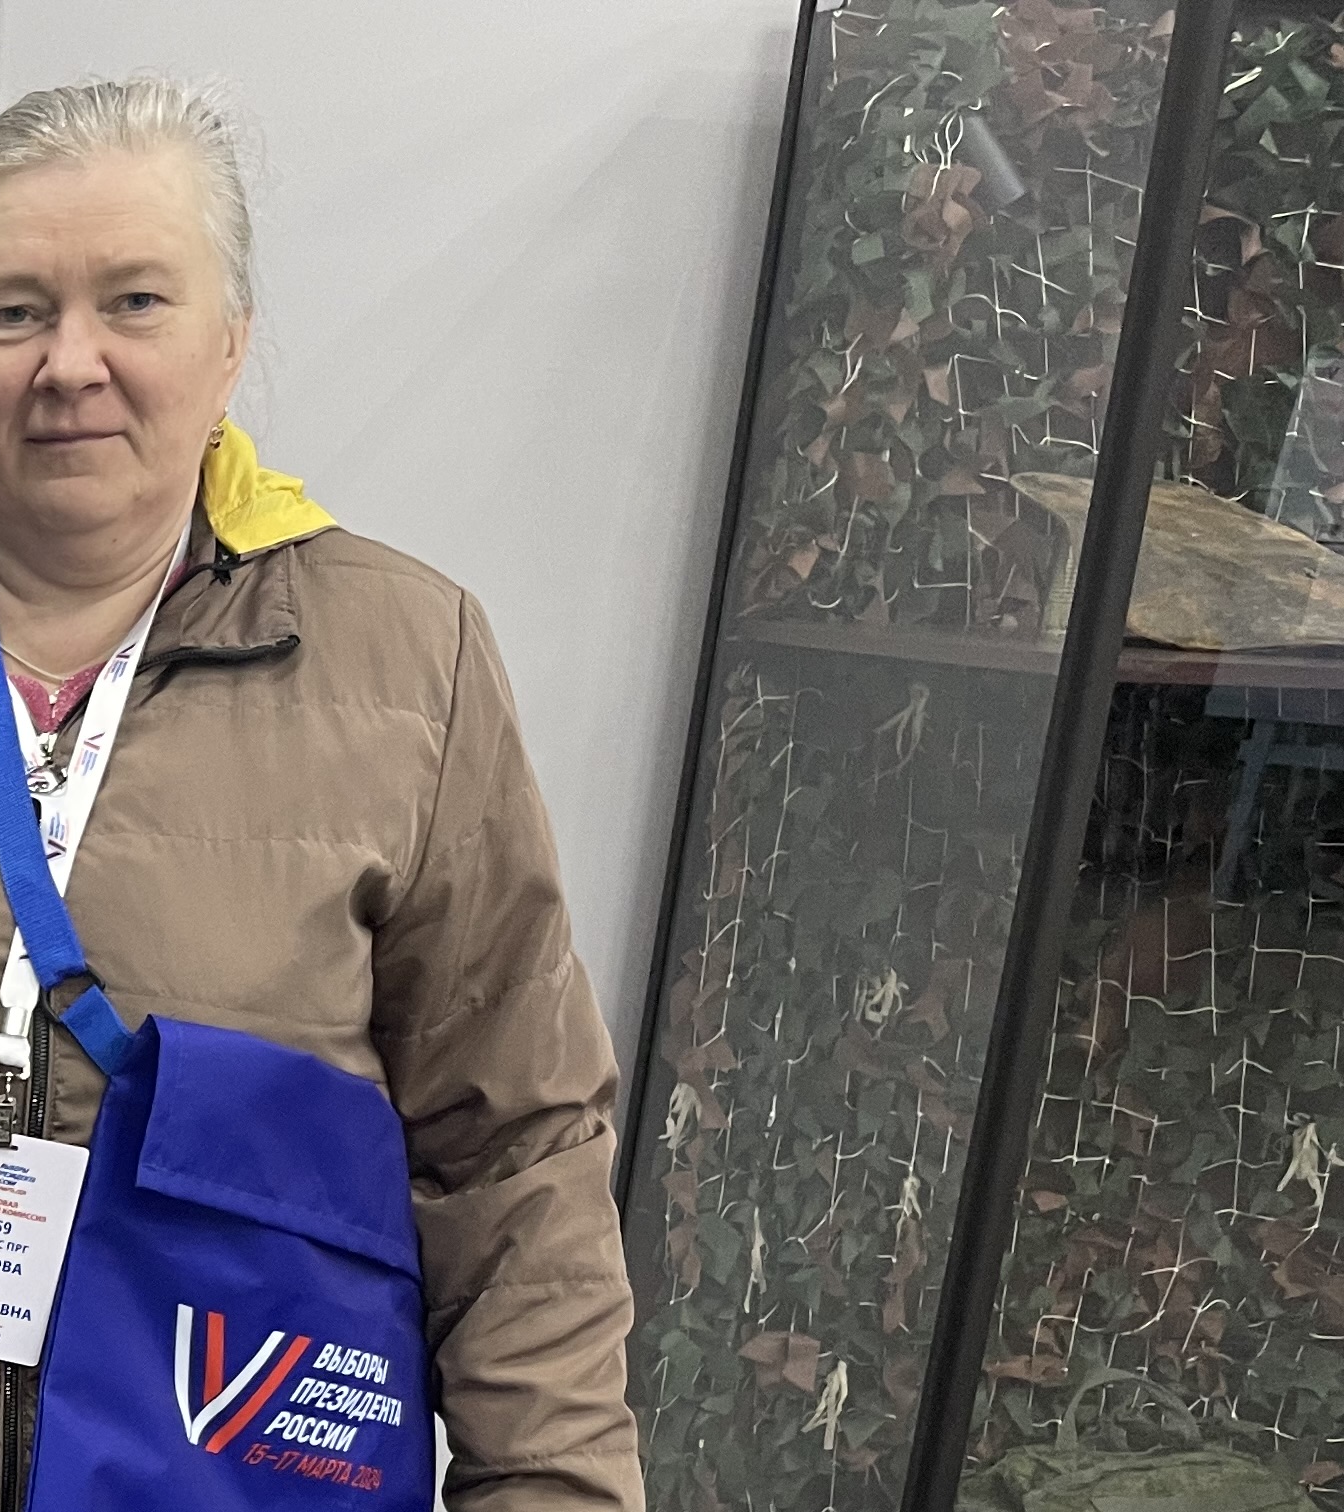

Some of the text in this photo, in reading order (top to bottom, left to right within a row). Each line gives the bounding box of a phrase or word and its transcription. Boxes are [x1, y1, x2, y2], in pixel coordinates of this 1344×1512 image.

[2, 1207, 47, 1222] КОМИССИЯ
[6, 1241, 30, 1254] ПРГ
[313, 1343, 389, 1385] ВЫБОРЫ
[289, 1377, 403, 1427] ПРЕЗИДЕНТА
[263, 1411, 358, 1452] РОССИИ
[294, 1454, 354, 1485] МАРТА
